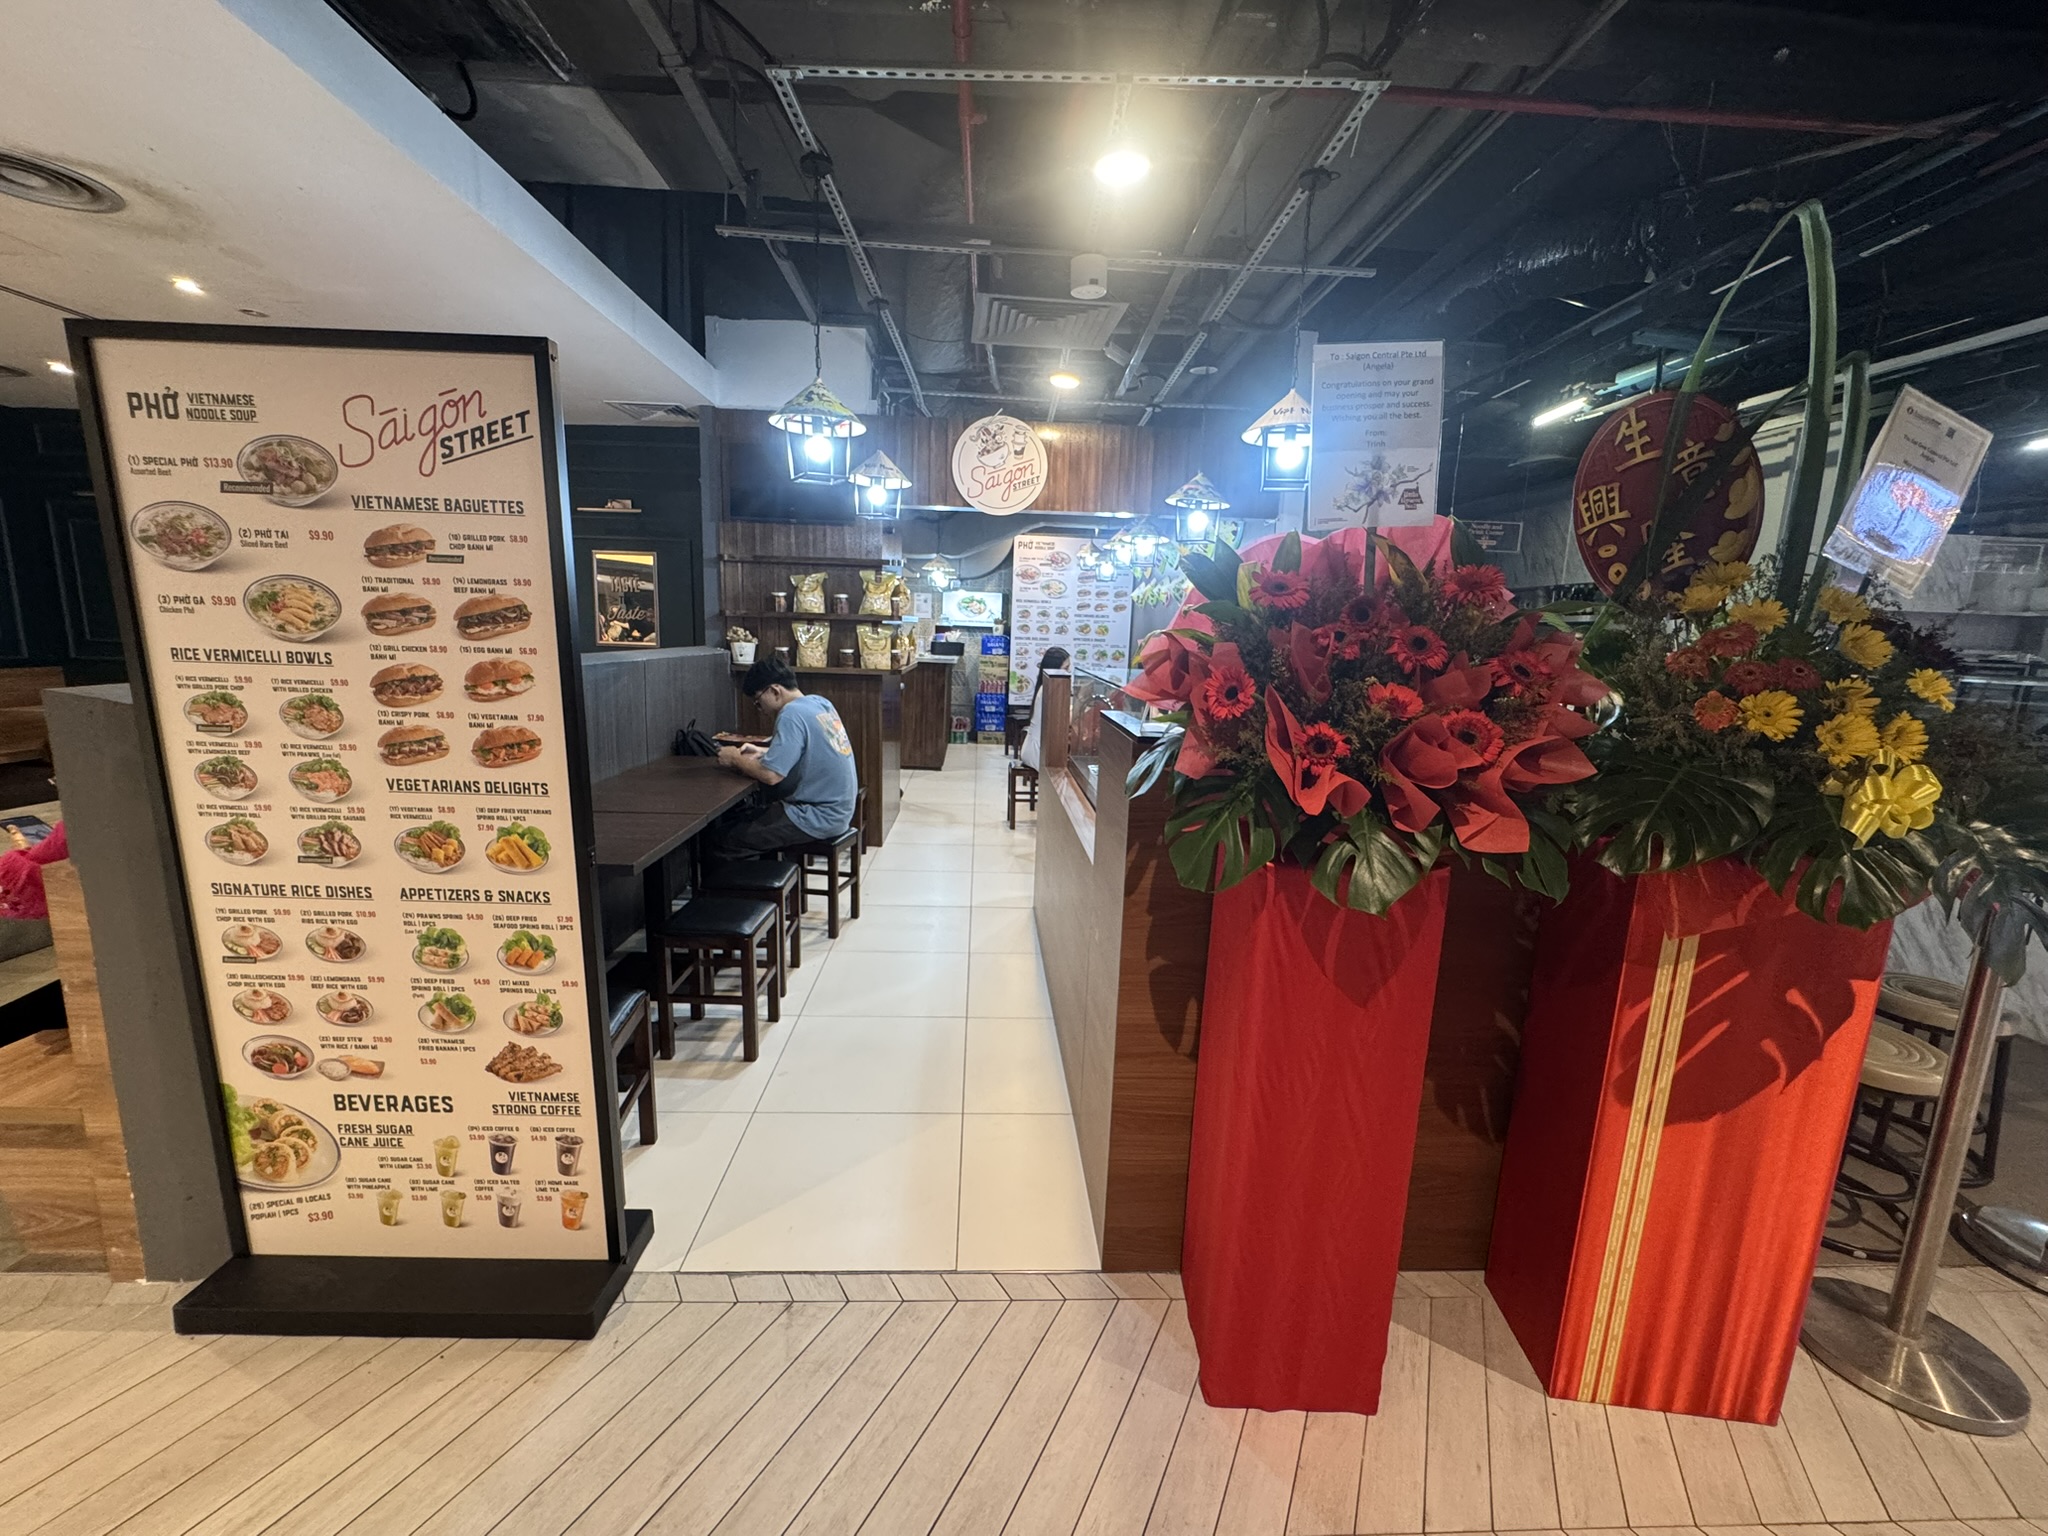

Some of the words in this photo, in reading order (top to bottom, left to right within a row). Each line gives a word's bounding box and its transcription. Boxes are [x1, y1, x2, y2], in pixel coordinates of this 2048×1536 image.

[1346, 352, 1370, 361] Saigon
[1401, 351, 1413, 359] Pte
[1415, 350, 1427, 358] Ltd
[1363, 363, 1394, 371] (Angela)
[1322, 381, 1380, 390] Congratulations
[1412, 379, 1434, 387] grand
[127, 386, 179, 419] PHỞ
[186, 393, 255, 406] VIETNAMESE
[186, 408, 227, 420] NOODLE
[230, 409, 257, 421] SOUP
[440, 410, 530, 459] STREET
[128, 456, 139, 466] (1)
[142, 456, 178, 466] SPECIAL
[203, 459, 233, 469] $13.90
[1013, 476, 1040, 490] STREET
[351, 495, 439, 511] VIETNAMESE
[444, 498, 524, 514] BAGUETTES
[238, 529, 251, 539] (2)
[309, 530, 333, 541] $9.90
[463, 534, 487, 542] GRILLED
[509, 535, 528, 543] $8.90
[467, 578, 507, 586] LEMONGRASS
[158, 595, 170, 605] (3)
[211, 596, 236, 606] $9.90
[171, 647, 200, 660] RICE
[204, 648, 281, 663] VERMICELLI
[286, 651, 332, 664] BOWLS
[386, 778, 480, 793] VEGETARIANS
[485, 781, 549, 794] DELIGHTS
[211, 882, 286, 896] SIGNATURE
[292, 885, 321, 897] RICE
[326, 885, 372, 898] DISHES
[400, 888, 480, 901] APPETIZERS
[484, 890, 493, 902] &
[499, 890, 550, 903] SNACKS
[333, 1093, 454, 1113] BEVERAGES
[508, 1091, 579, 1102] VIETNAMESE
[492, 1104, 536, 1115] STRONG
[541, 1105, 581, 1115] COFFEE
[338, 1124, 372, 1134] FRESH
[376, 1124, 412, 1134] SUGAR
[340, 1137, 369, 1147] CANE
[373, 1138, 403, 1147] JUICE
[266, 1199, 293, 1208] SPECIAL
[305, 1193, 331, 1202] LOCALS
[308, 1211, 334, 1222] $3.90
